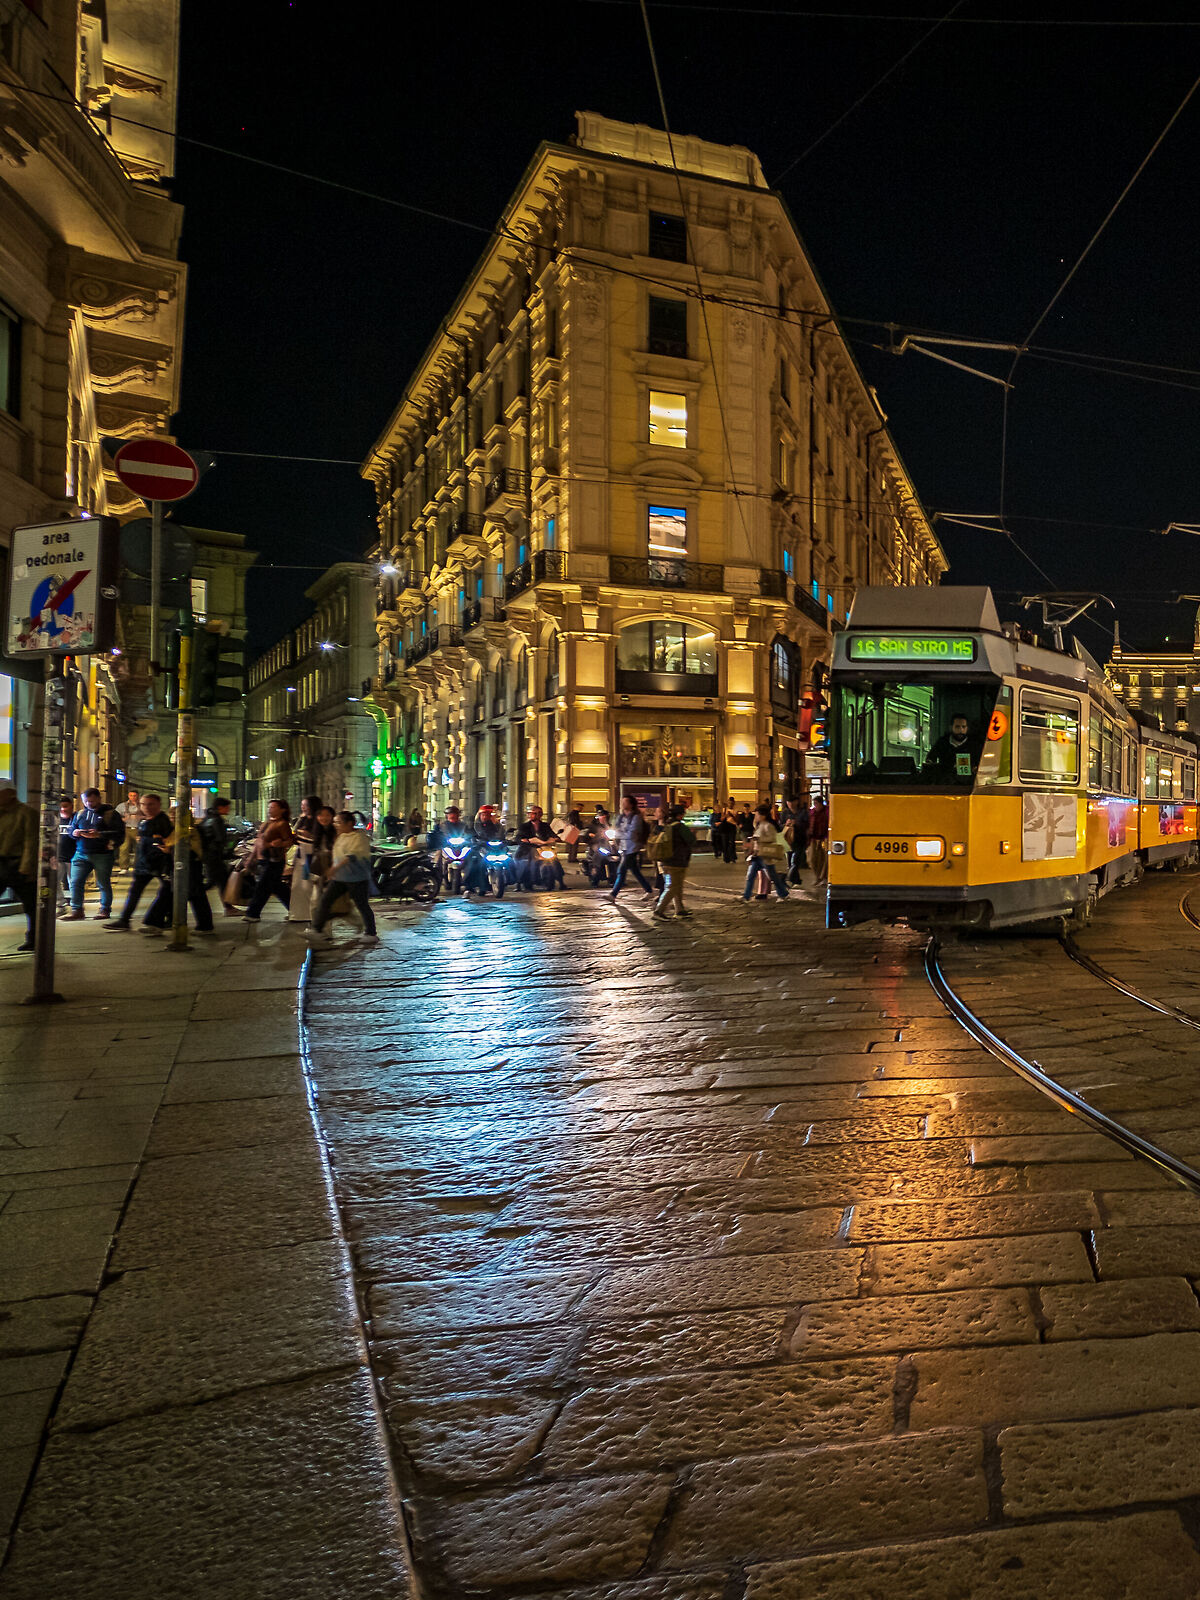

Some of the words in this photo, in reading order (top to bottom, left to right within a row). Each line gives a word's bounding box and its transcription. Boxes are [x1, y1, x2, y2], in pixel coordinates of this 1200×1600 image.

[42, 532, 70, 545] area
[26, 548, 84, 568] pedonale
[857, 640, 876, 654] 16
[879, 640, 908, 655] SAN
[912, 641, 948, 655] SIRO
[952, 641, 972, 655] M5
[874, 842, 909, 854] 4996
